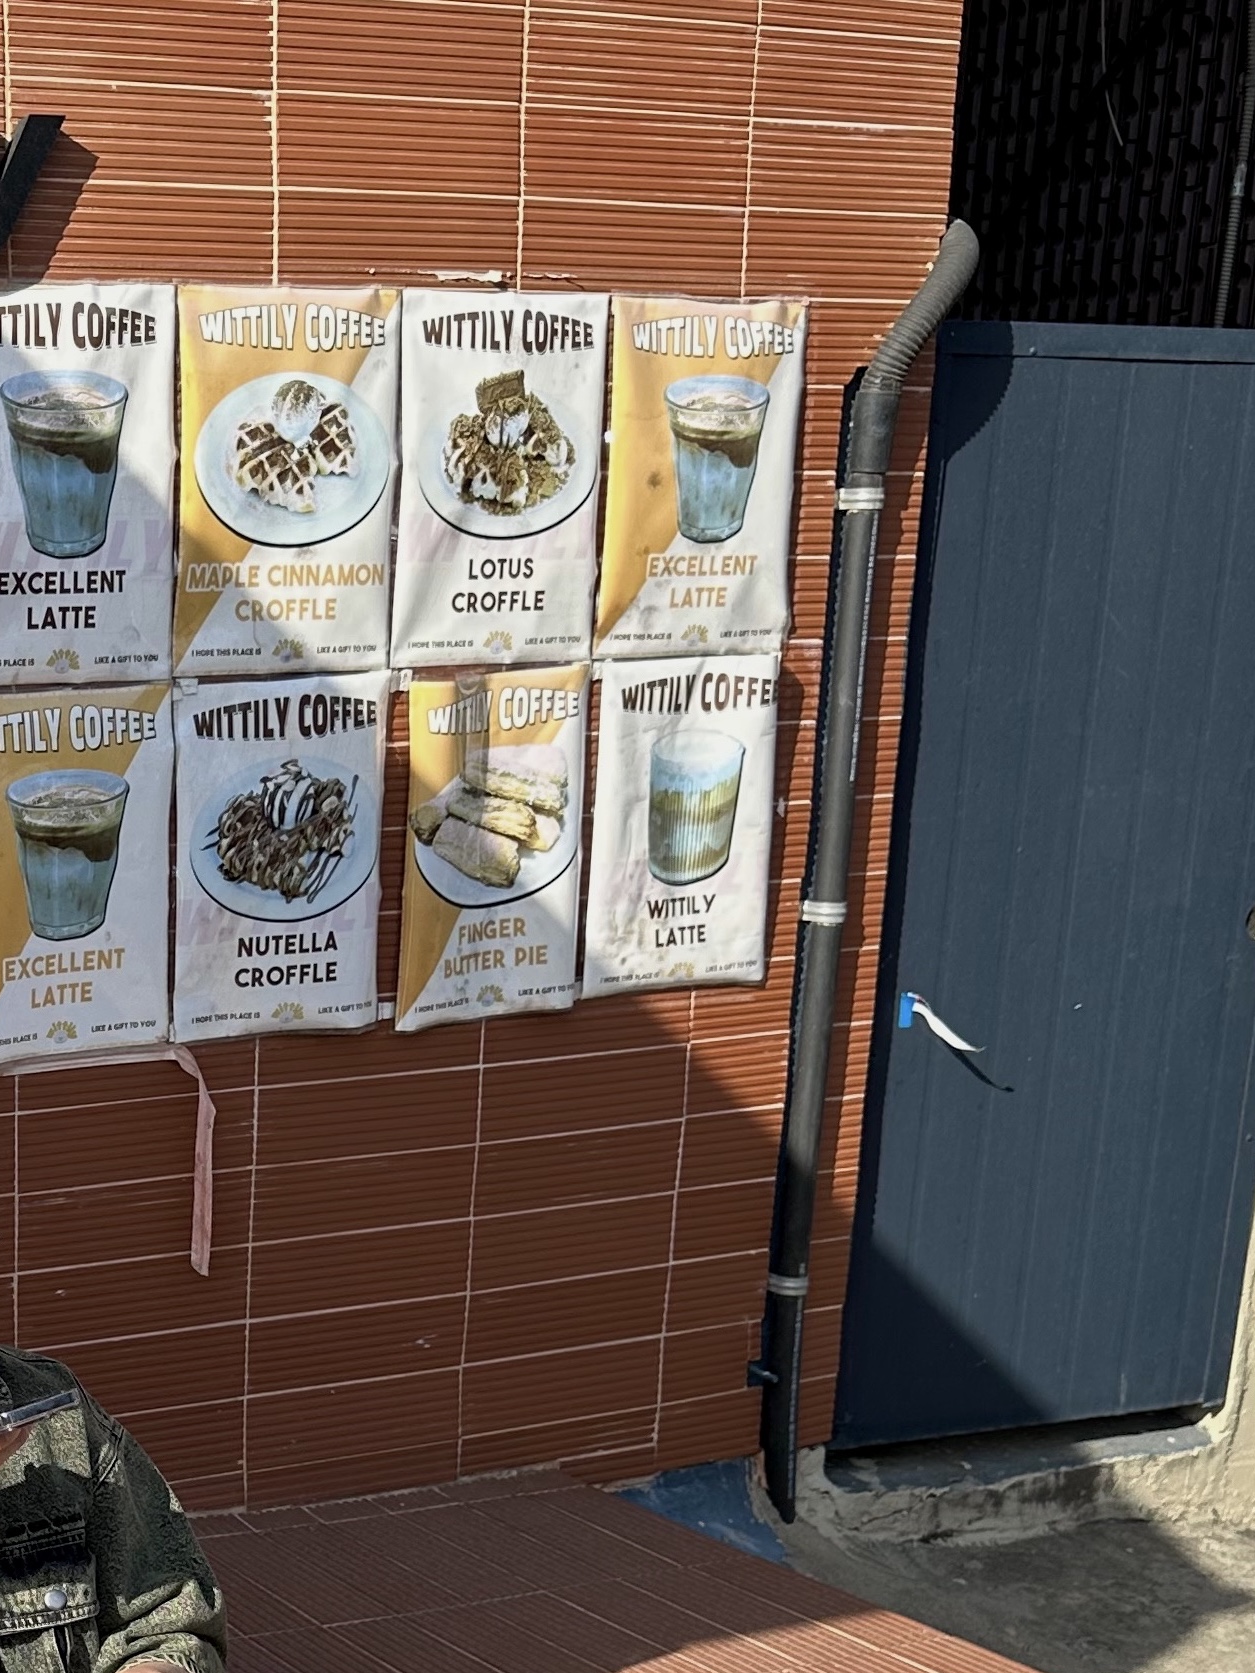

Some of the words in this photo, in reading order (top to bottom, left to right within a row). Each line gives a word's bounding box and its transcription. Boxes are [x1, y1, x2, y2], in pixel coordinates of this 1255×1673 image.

[72, 301, 157, 350] COFFEE
[198, 304, 297, 350] WITTILY
[304, 303, 386, 352] COFFEE
[423, 310, 514, 351] WITTILY
[522, 309, 594, 355] COFFEE
[632, 315, 718, 358] WITTILY
[724, 316, 795, 360] COFFEE
[186, 563, 259, 592] MAPLE
[267, 562, 385, 588] CINNAMON
[468, 558, 534, 580] LOTUS
[647, 554, 758, 578] EXCELLENT
[235, 598, 336, 622] CROFFLE
[451, 590, 545, 614] CROFFLE
[669, 586, 726, 609] LATTE
[27, 605, 96, 630] LATTE
[621, 674, 696, 715] WITTILY
[192, 696, 290, 741] WITTILY
[298, 694, 378, 741] COFFEE
[427, 690, 493, 735] WITTILY
[499, 686, 580, 731] COFFEE
[69, 705, 156, 752] COFFEE
[647, 893, 716, 920] WITTILY
[458, 917, 526, 942] FINGER
[655, 924, 706, 949] LATTE
[236, 931, 338, 958] NUTELLA
[3, 947, 125, 982] EXCELLENT
[234, 961, 337, 988] CROFFLE
[444, 949, 504, 978] BUTTER
[514, 945, 548, 966] PIE
[31, 982, 93, 1009] LATTE
